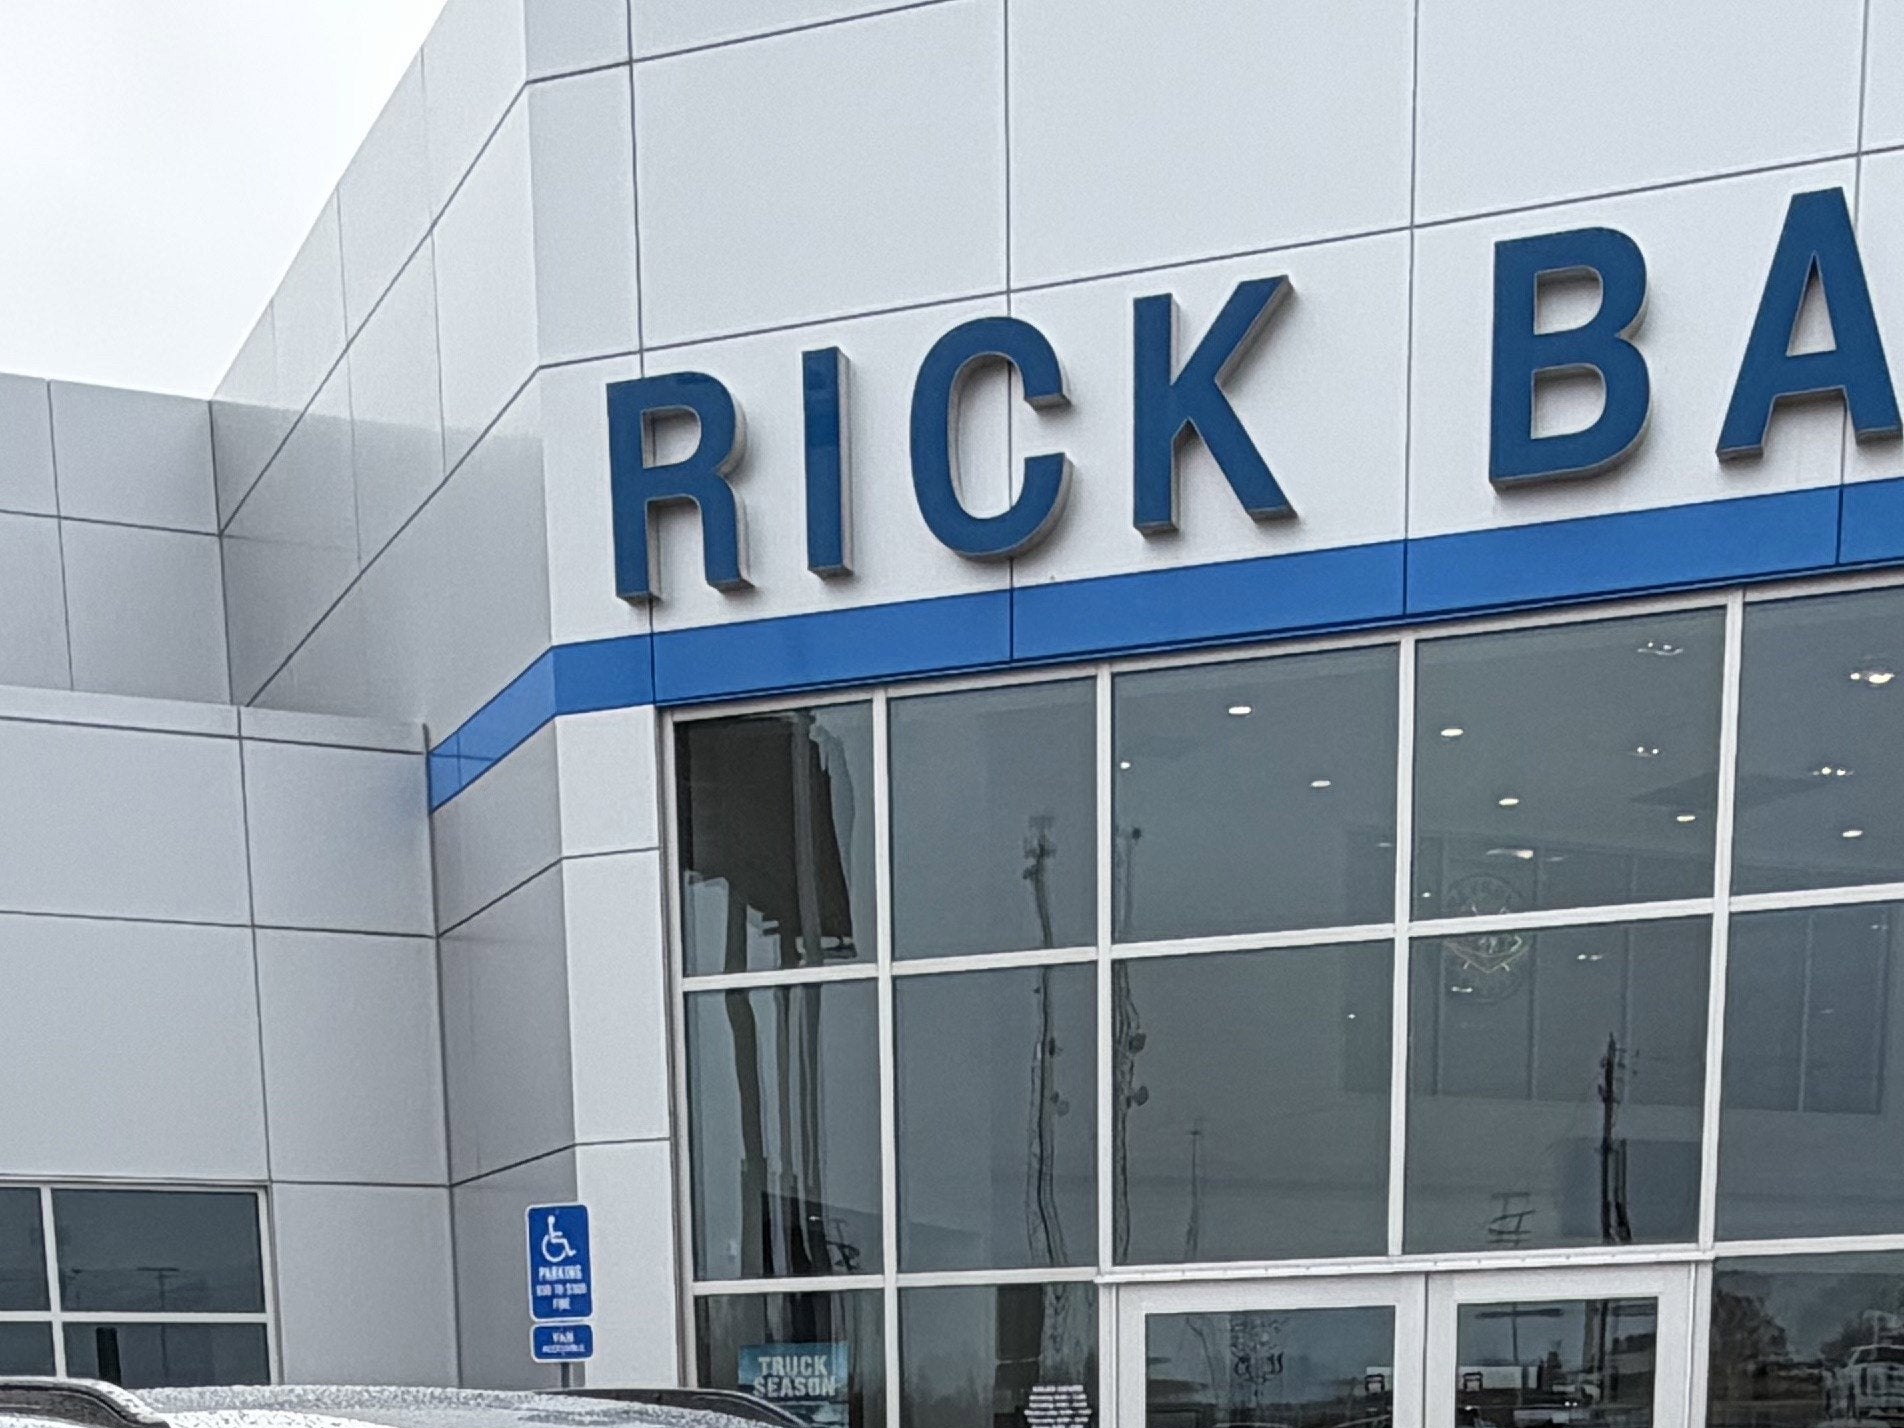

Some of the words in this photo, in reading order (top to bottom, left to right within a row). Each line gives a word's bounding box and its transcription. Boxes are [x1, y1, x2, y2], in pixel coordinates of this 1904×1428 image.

[605, 275, 1299, 609] RICK
[539, 1264, 582, 1281] PARKING
[757, 1354, 828, 1376] TRUCK
[753, 1375, 836, 1398] SEASON
